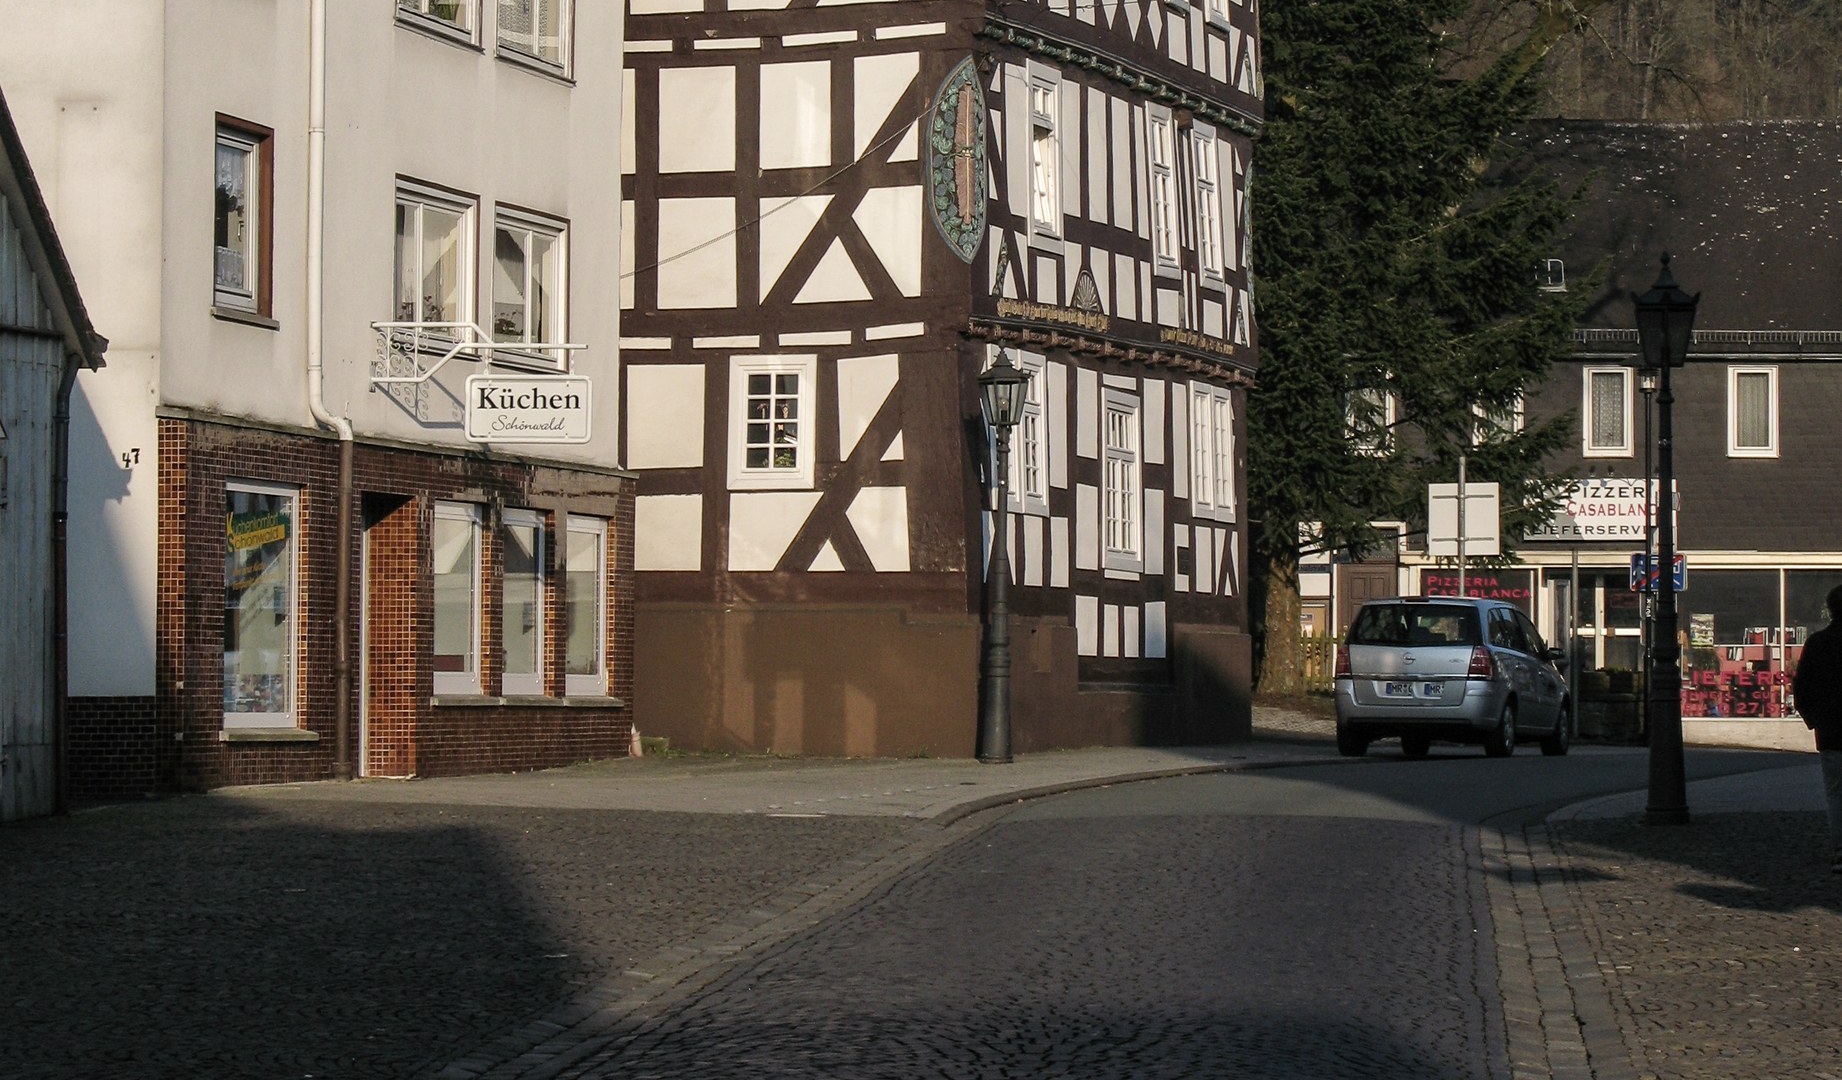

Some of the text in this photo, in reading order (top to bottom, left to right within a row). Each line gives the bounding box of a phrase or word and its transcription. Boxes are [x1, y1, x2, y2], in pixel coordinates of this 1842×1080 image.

[477, 387, 581, 410] Küchen
[491, 414, 566, 431] Schönwald
[122, 448, 140, 468] 47
[1568, 484, 1645, 498] PIZZER
[1533, 525, 1647, 535] LIEFERSERVI
[1427, 576, 1498, 586] PIZZERIA
[1427, 588, 1531, 598] CASBLANCA
